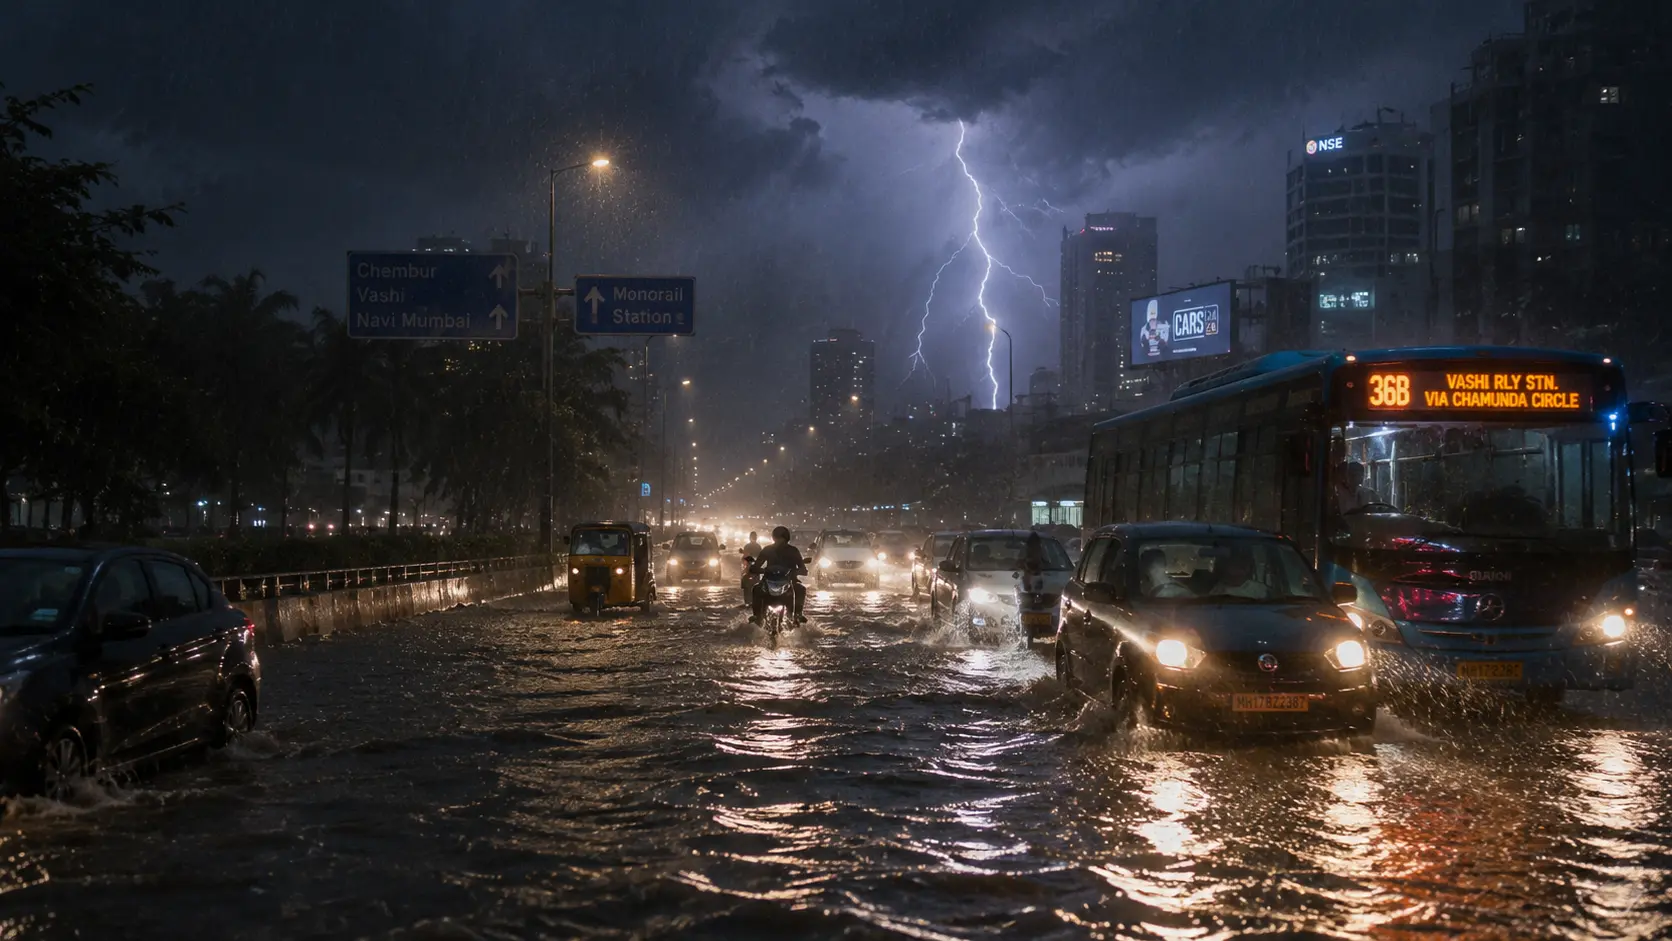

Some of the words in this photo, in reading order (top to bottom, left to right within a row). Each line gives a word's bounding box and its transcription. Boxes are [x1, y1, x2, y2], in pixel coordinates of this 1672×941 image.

[1318, 137, 1343, 152] NSE
[357, 262, 437, 279] Chembur
[357, 287, 405, 304] Vashi
[613, 286, 684, 302] Monorail
[357, 312, 396, 328] Navi
[402, 312, 471, 328] Mumbai
[612, 308, 672, 325] Station
[1175, 310, 1204, 336] CARS
[1446, 373, 1490, 390] VASHI
[1494, 373, 1522, 390] RLY
[1526, 373, 1559, 390] STN.
[1368, 374, 1411, 407] 36B
[1424, 391, 1449, 408] VIA
[1452, 391, 1528, 408] CHAMUNDA
[1531, 391, 1580, 408] CIRCLE
